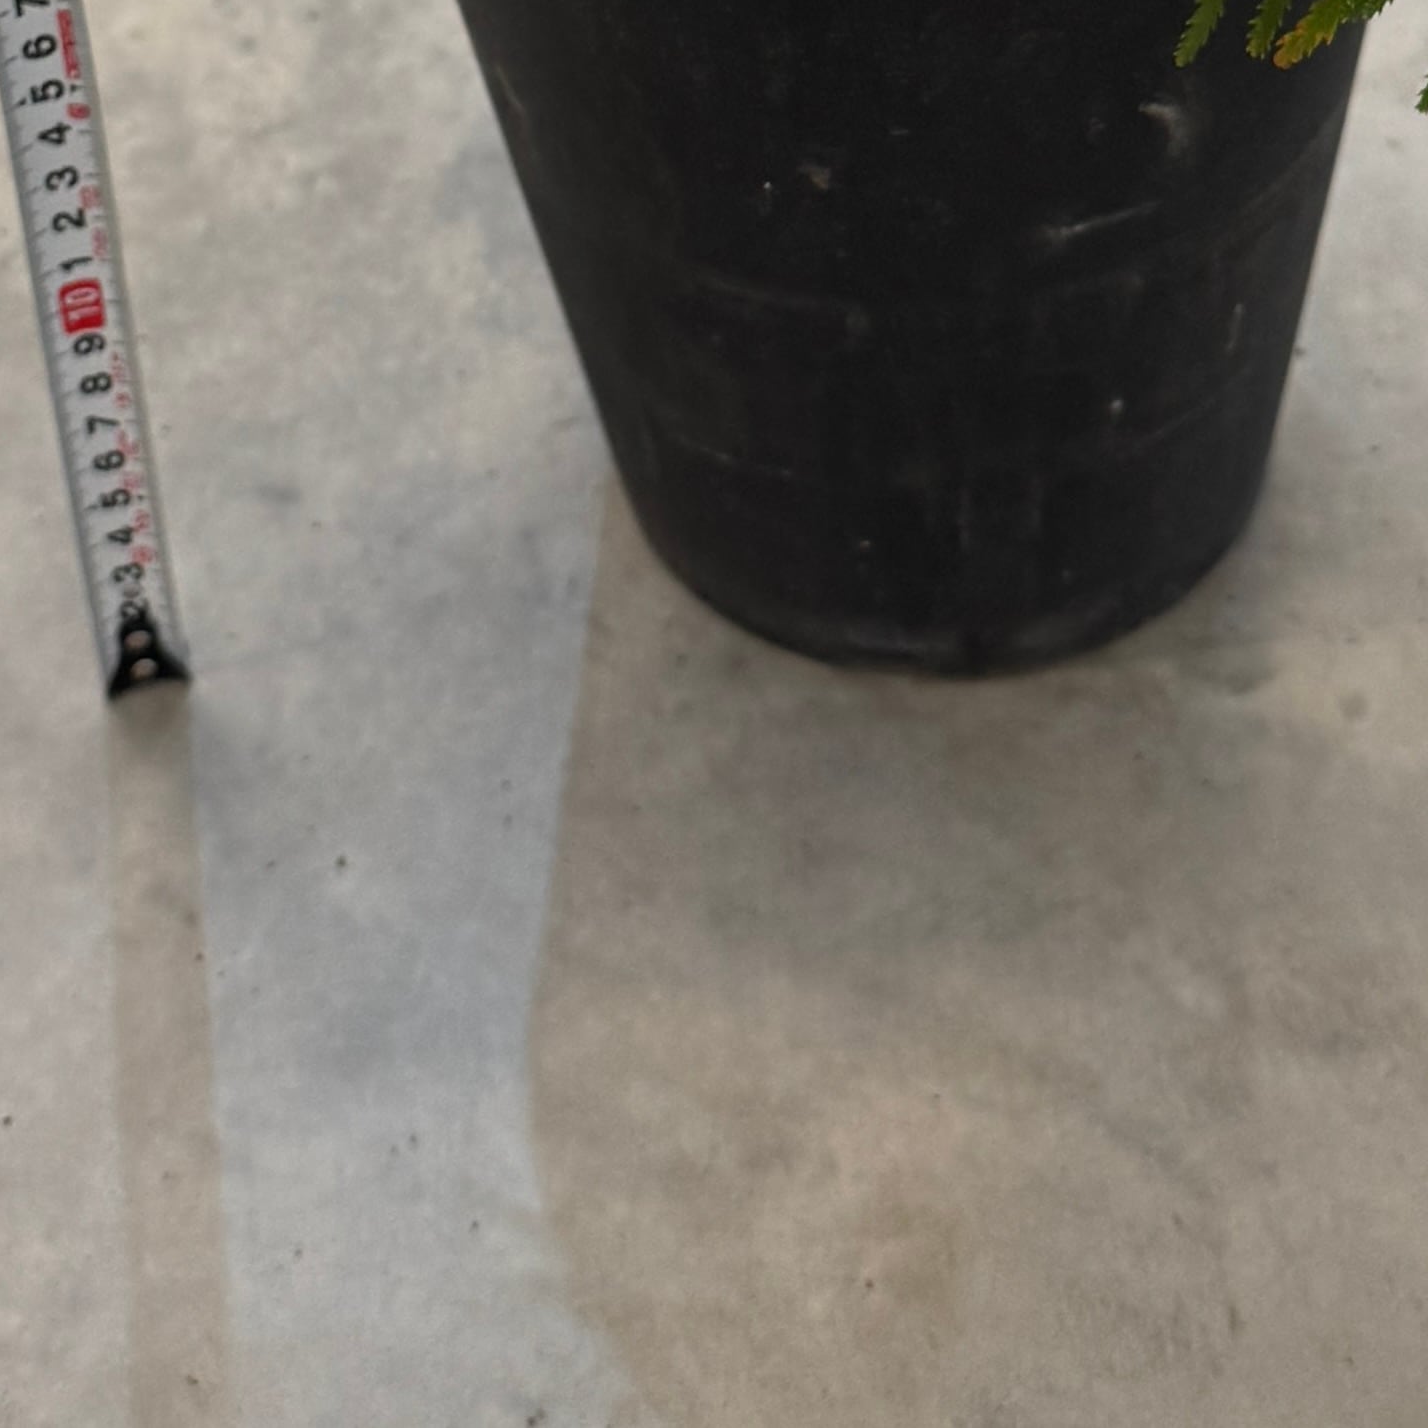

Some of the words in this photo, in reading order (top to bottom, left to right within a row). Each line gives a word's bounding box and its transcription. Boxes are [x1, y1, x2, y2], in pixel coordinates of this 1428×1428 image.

[22, 34, 57, 60] 6
[30, 79, 65, 104] 5
[37, 123, 71, 145] 4
[45, 166, 79, 191] 3
[52, 208, 86, 233] 2
[61, 256, 92, 272] 1
[67, 284, 102, 323] 10
[73, 334, 105, 355] 9
[79, 373, 112, 395] 8
[86, 417, 119, 435] 7
[93, 450, 125, 471] 6
[101, 489, 131, 509] 5
[107, 527, 134, 545] 4
